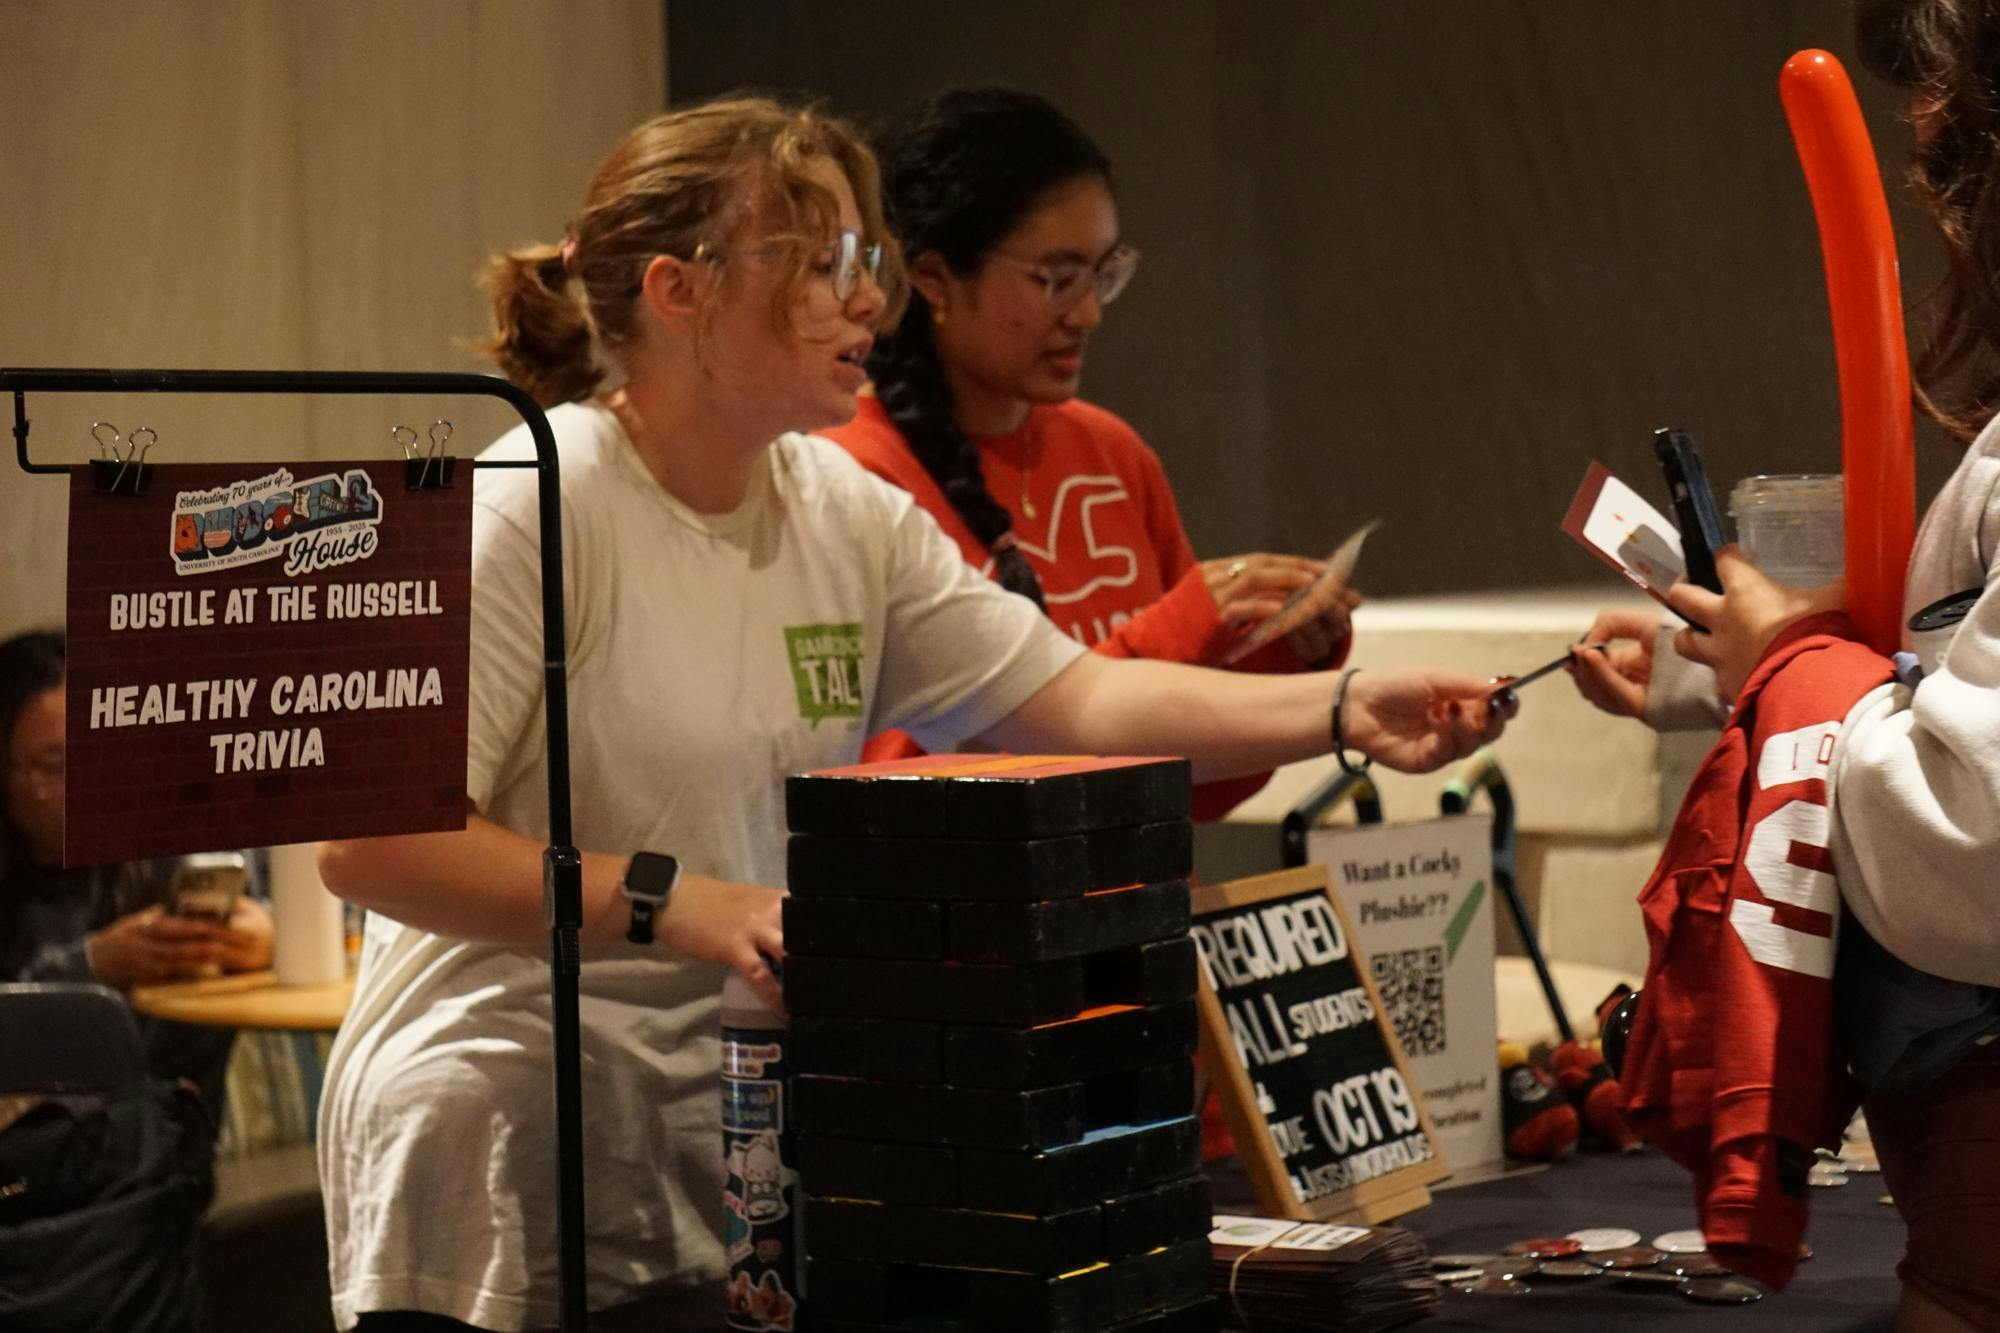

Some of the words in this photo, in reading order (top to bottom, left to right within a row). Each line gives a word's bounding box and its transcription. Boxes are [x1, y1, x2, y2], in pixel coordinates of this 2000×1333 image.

[179, 491, 230, 508] Celebrating
[233, 485, 245, 498] 70
[248, 479, 272, 499] years
[179, 559, 216, 571] UNIVERSITY
[227, 554, 248, 564] SOUTH
[249, 545, 282, 560] CAROLINA
[288, 531, 375, 571] House
[110, 589, 215, 631] BUSTLE
[224, 587, 259, 624] AT
[267, 585, 317, 621] THE
[327, 580, 443, 620] RUSSELL
[89, 677, 258, 729] HEALTHY
[270, 667, 443, 716] CAROLINA
[209, 727, 325, 774] TRIVIA
[1343, 860, 1390, 884] Want
[1395, 863, 1406, 879] a
[1227, 993, 1309, 1070] ALL
[1288, 987, 1375, 1040] STUDENTS
[1313, 1074, 1384, 1155] OCT
[1370, 1066, 1419, 1135] 19
